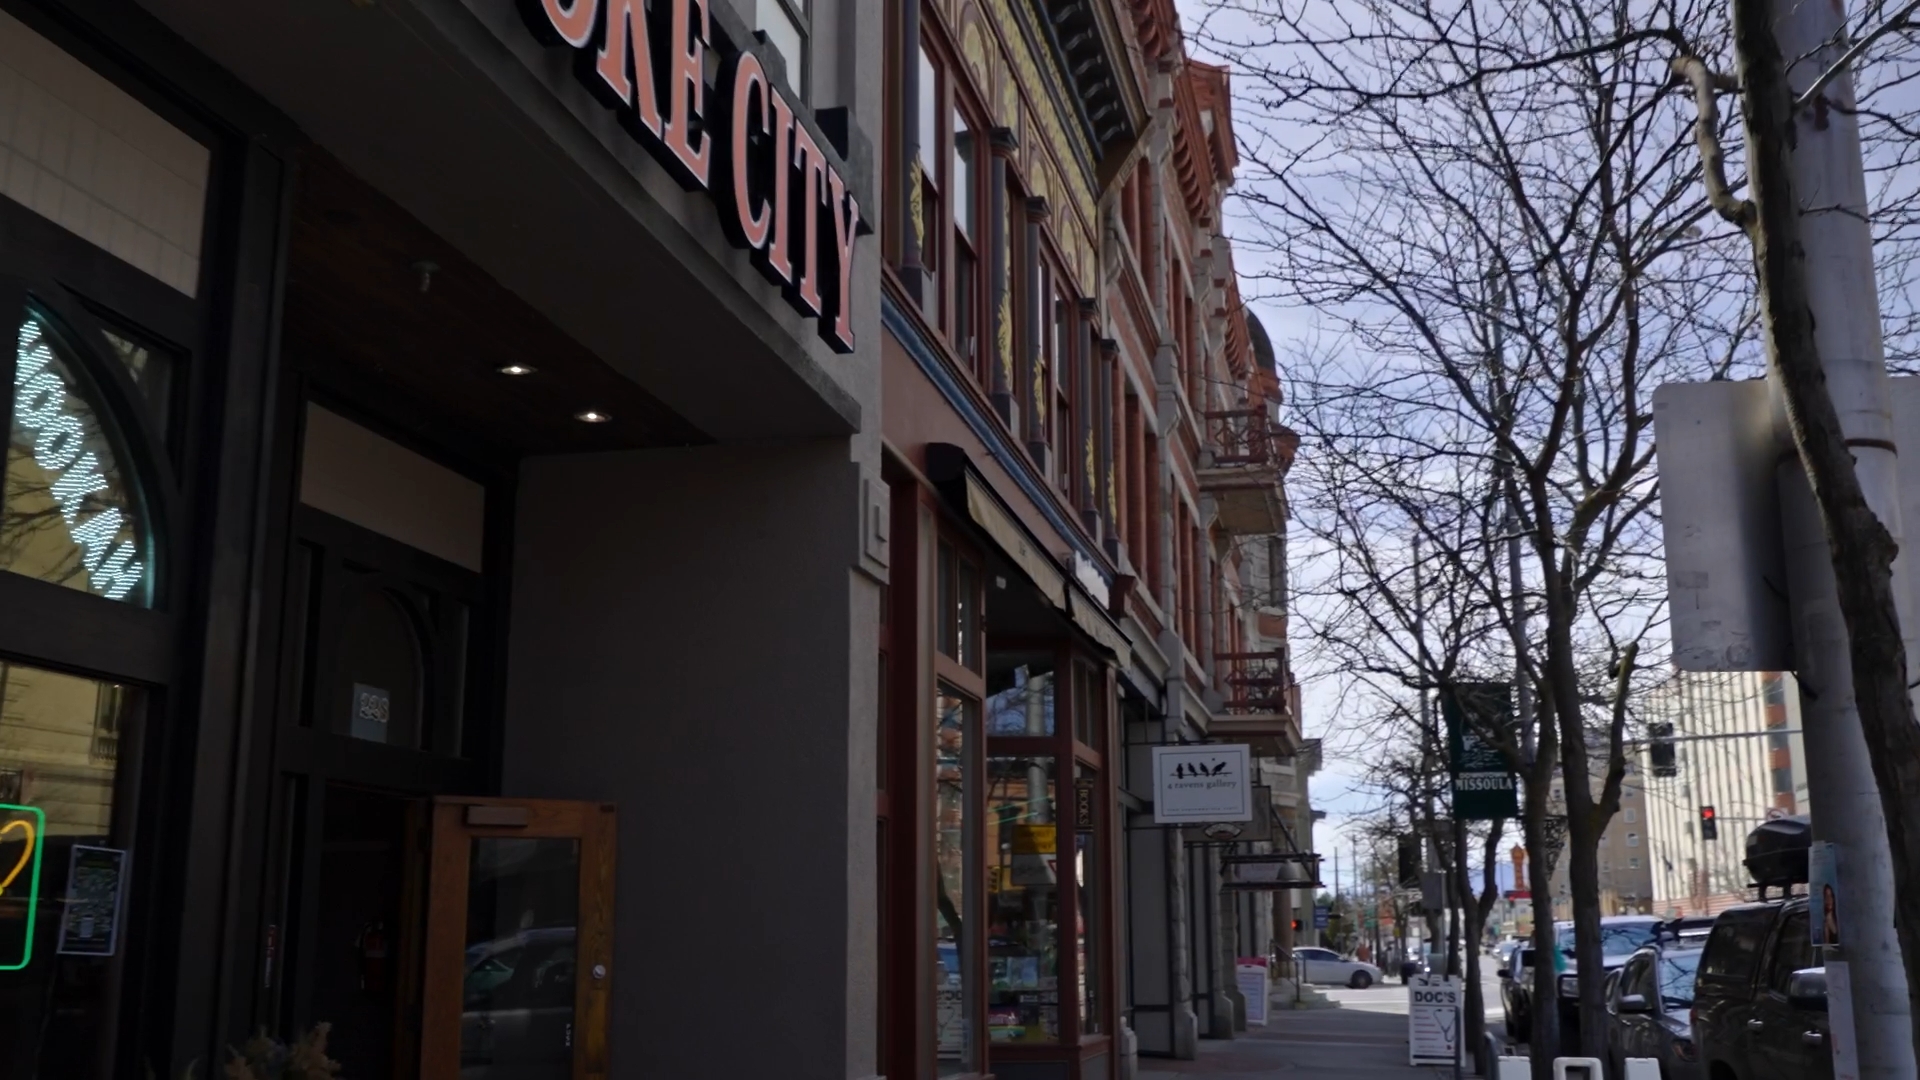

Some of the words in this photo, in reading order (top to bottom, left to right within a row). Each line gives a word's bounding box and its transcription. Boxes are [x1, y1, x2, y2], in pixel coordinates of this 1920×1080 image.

[541, 0, 711, 190] KE
[732, 50, 860, 353] CITY
[1206, 779, 1237, 790] gallery
[1455, 778, 1513, 791] MISSOULA
[1078, 789, 1089, 825] BOOKS
[1414, 991, 1456, 1003] DOC'S
